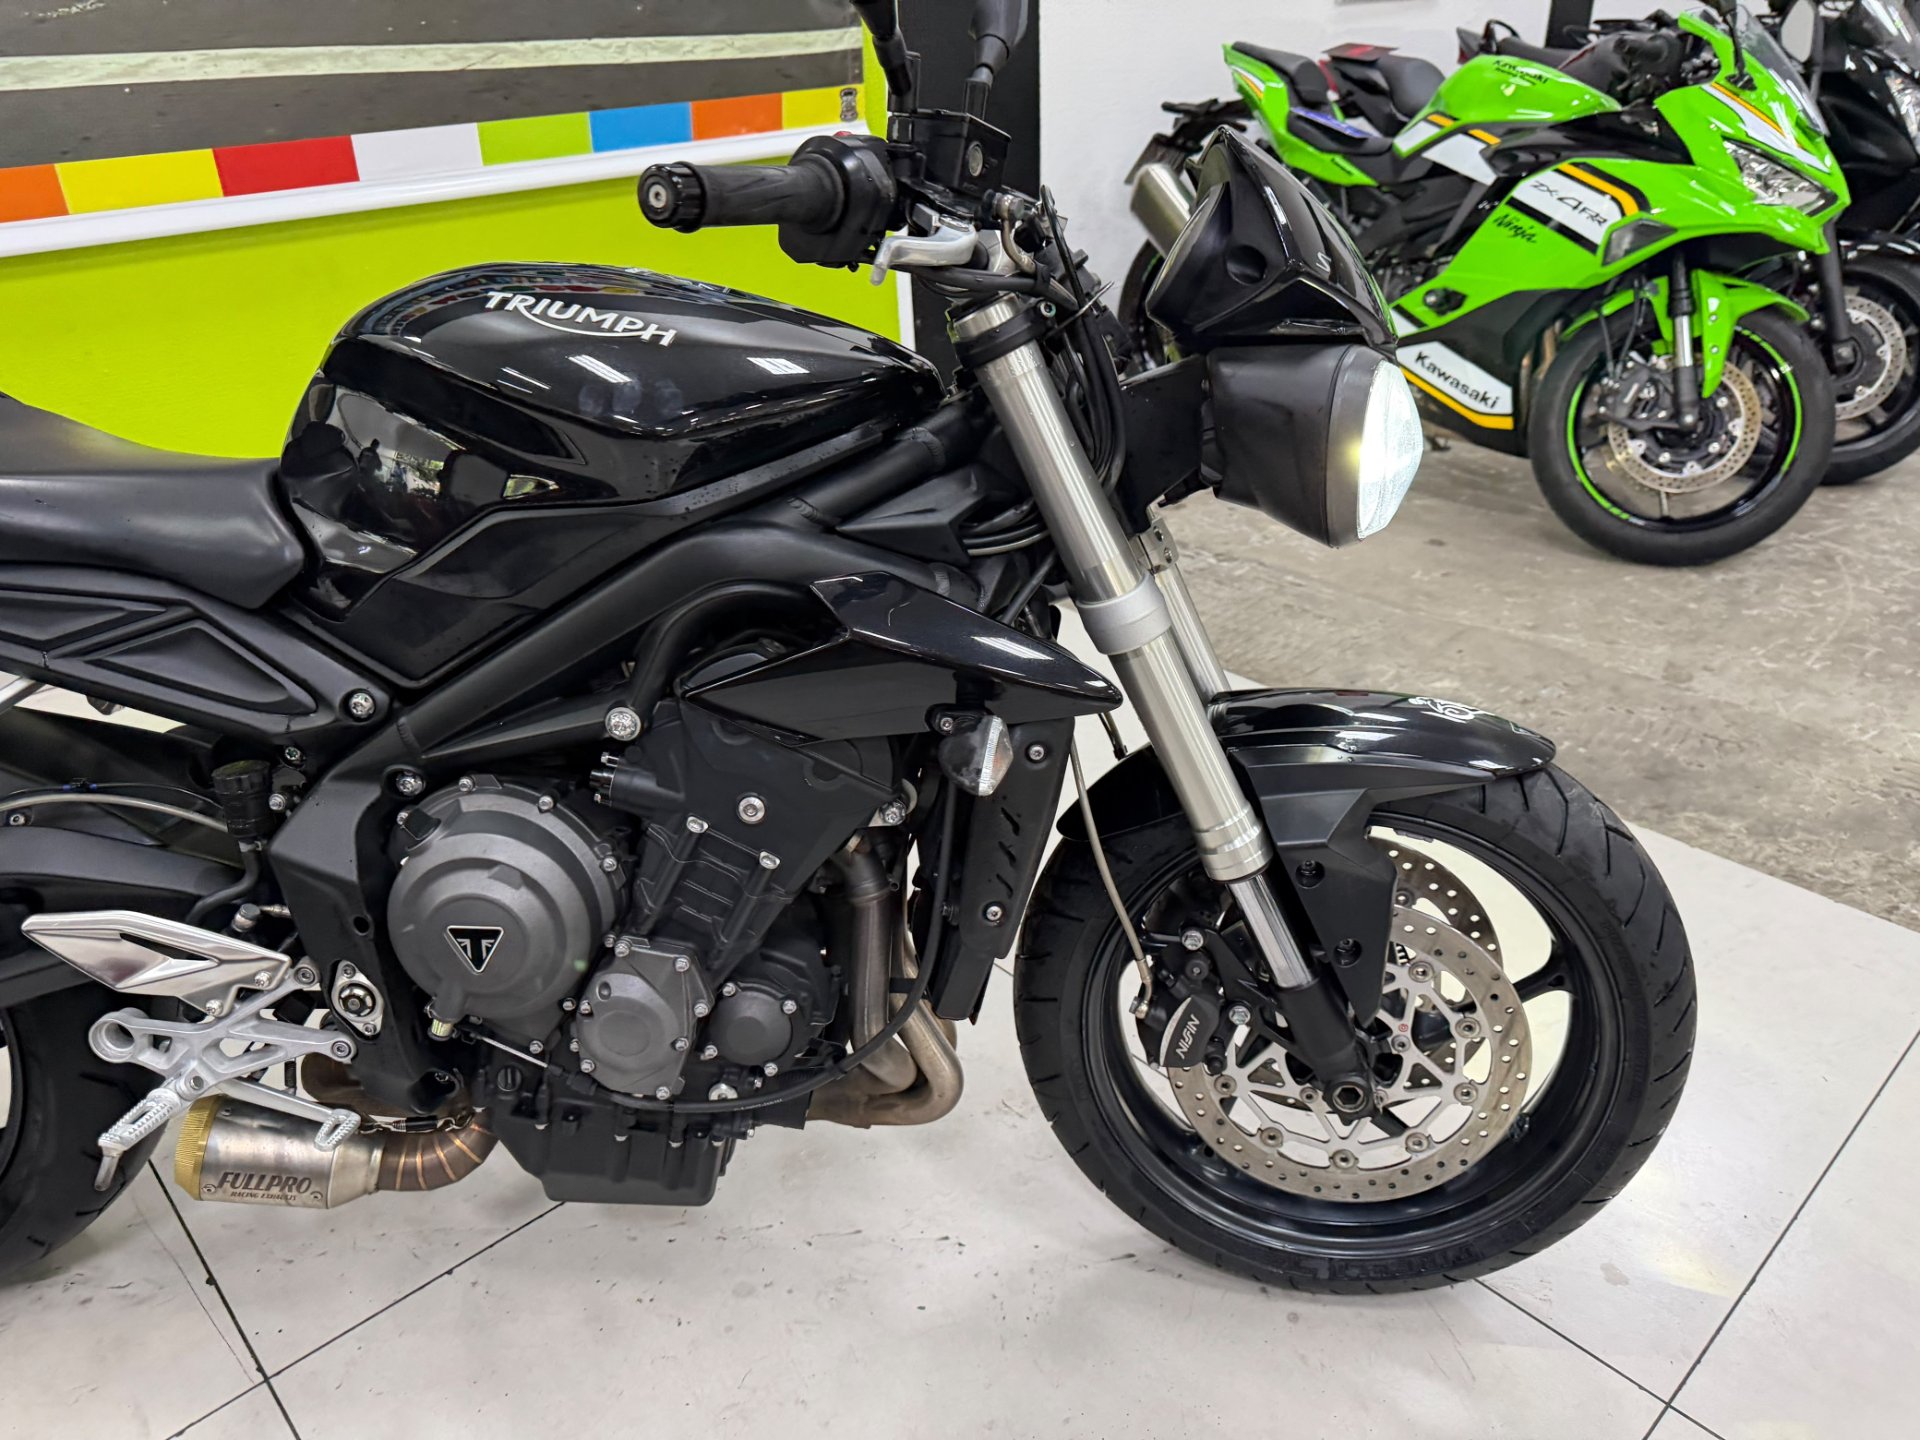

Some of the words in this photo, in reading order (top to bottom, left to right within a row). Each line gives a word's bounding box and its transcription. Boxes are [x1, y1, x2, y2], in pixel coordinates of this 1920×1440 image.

[485, 290, 677, 347] TRIUMPH
[1415, 351, 1500, 409] Kawasaki
[1176, 1013, 1200, 1060] NISSIN
[217, 1171, 312, 1194] FULLPRO
